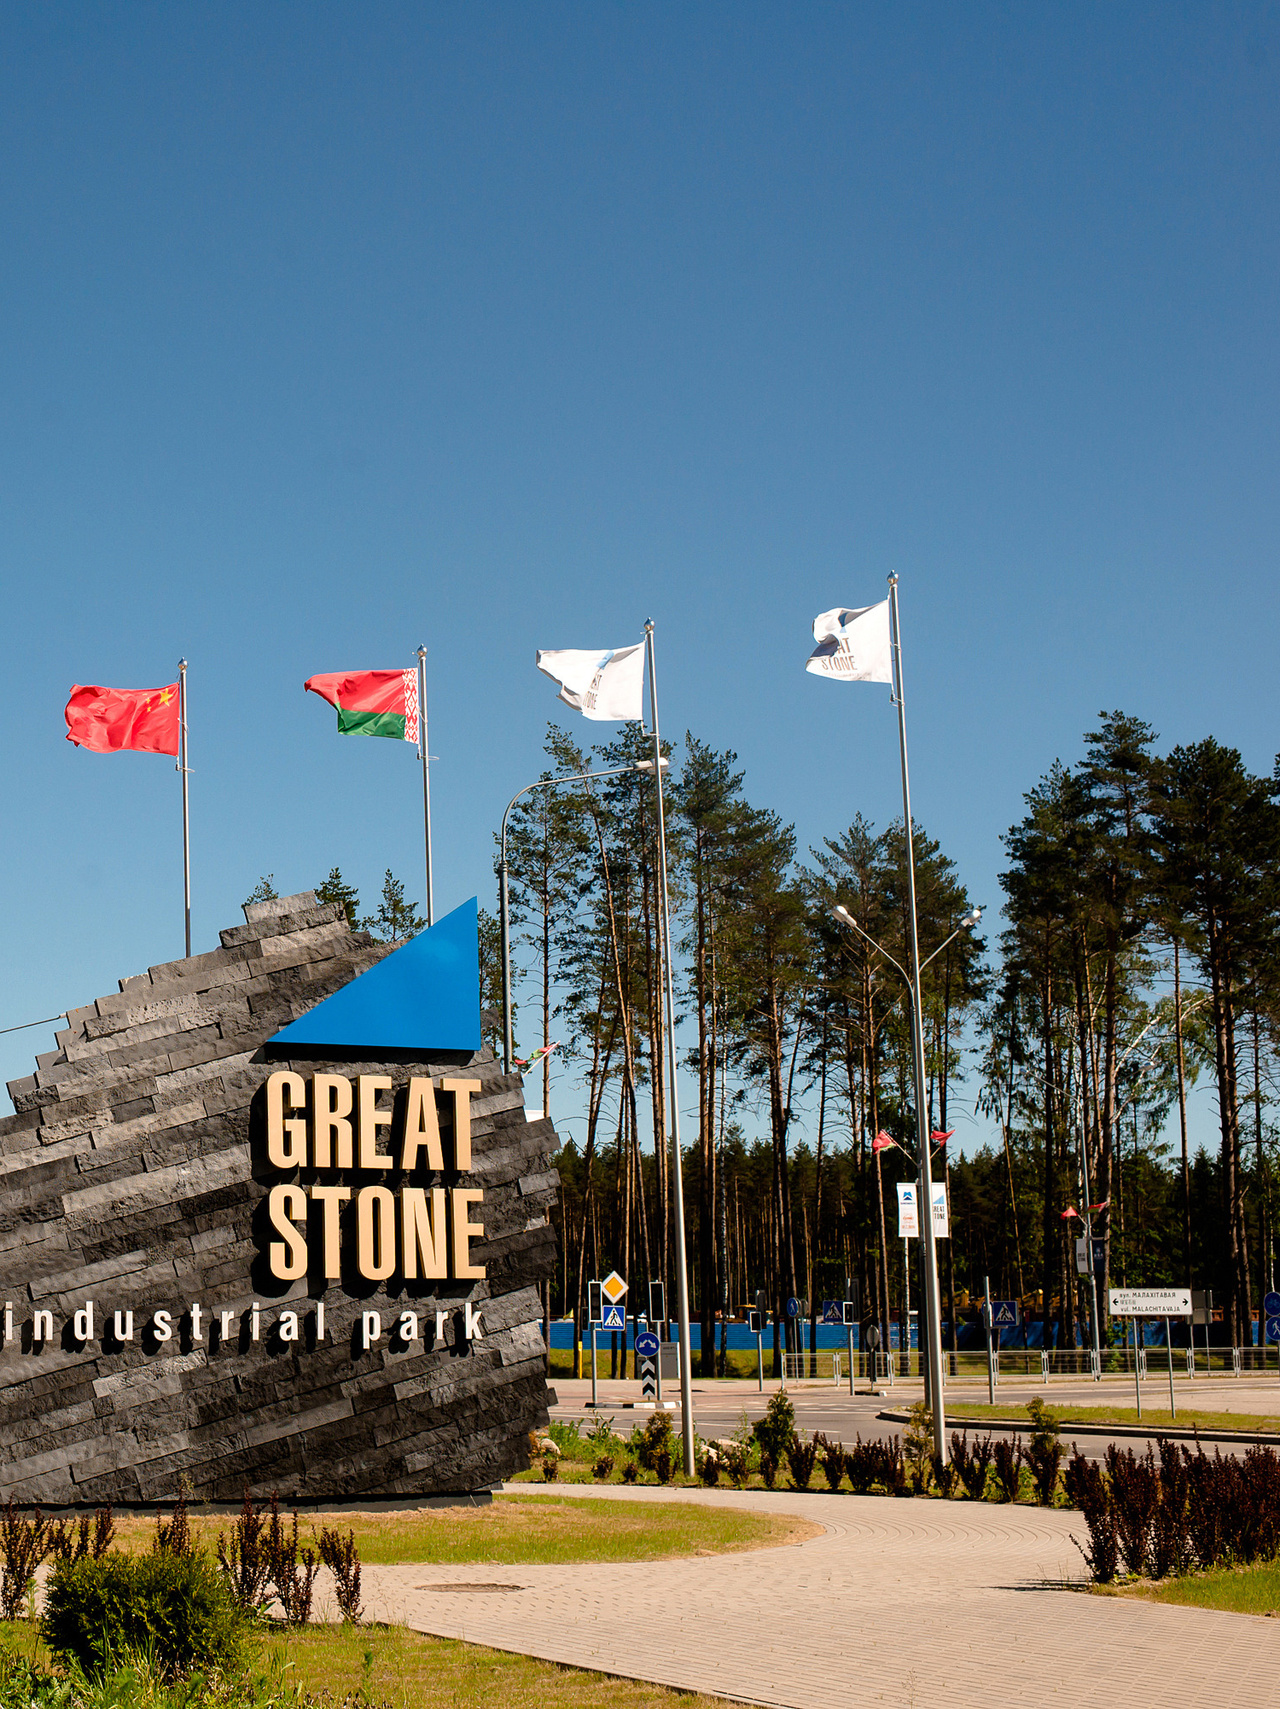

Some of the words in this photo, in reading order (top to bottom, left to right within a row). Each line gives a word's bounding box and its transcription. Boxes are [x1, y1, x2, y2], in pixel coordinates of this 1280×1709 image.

[266, 1070, 482, 1171] GREAT
[269, 1184, 487, 1281] STONE
[932, 1205, 946, 1213] REAT
[933, 1212, 946, 1220] TONE
[4, 1300, 325, 1341] industrial
[362, 1302, 483, 1350] park
